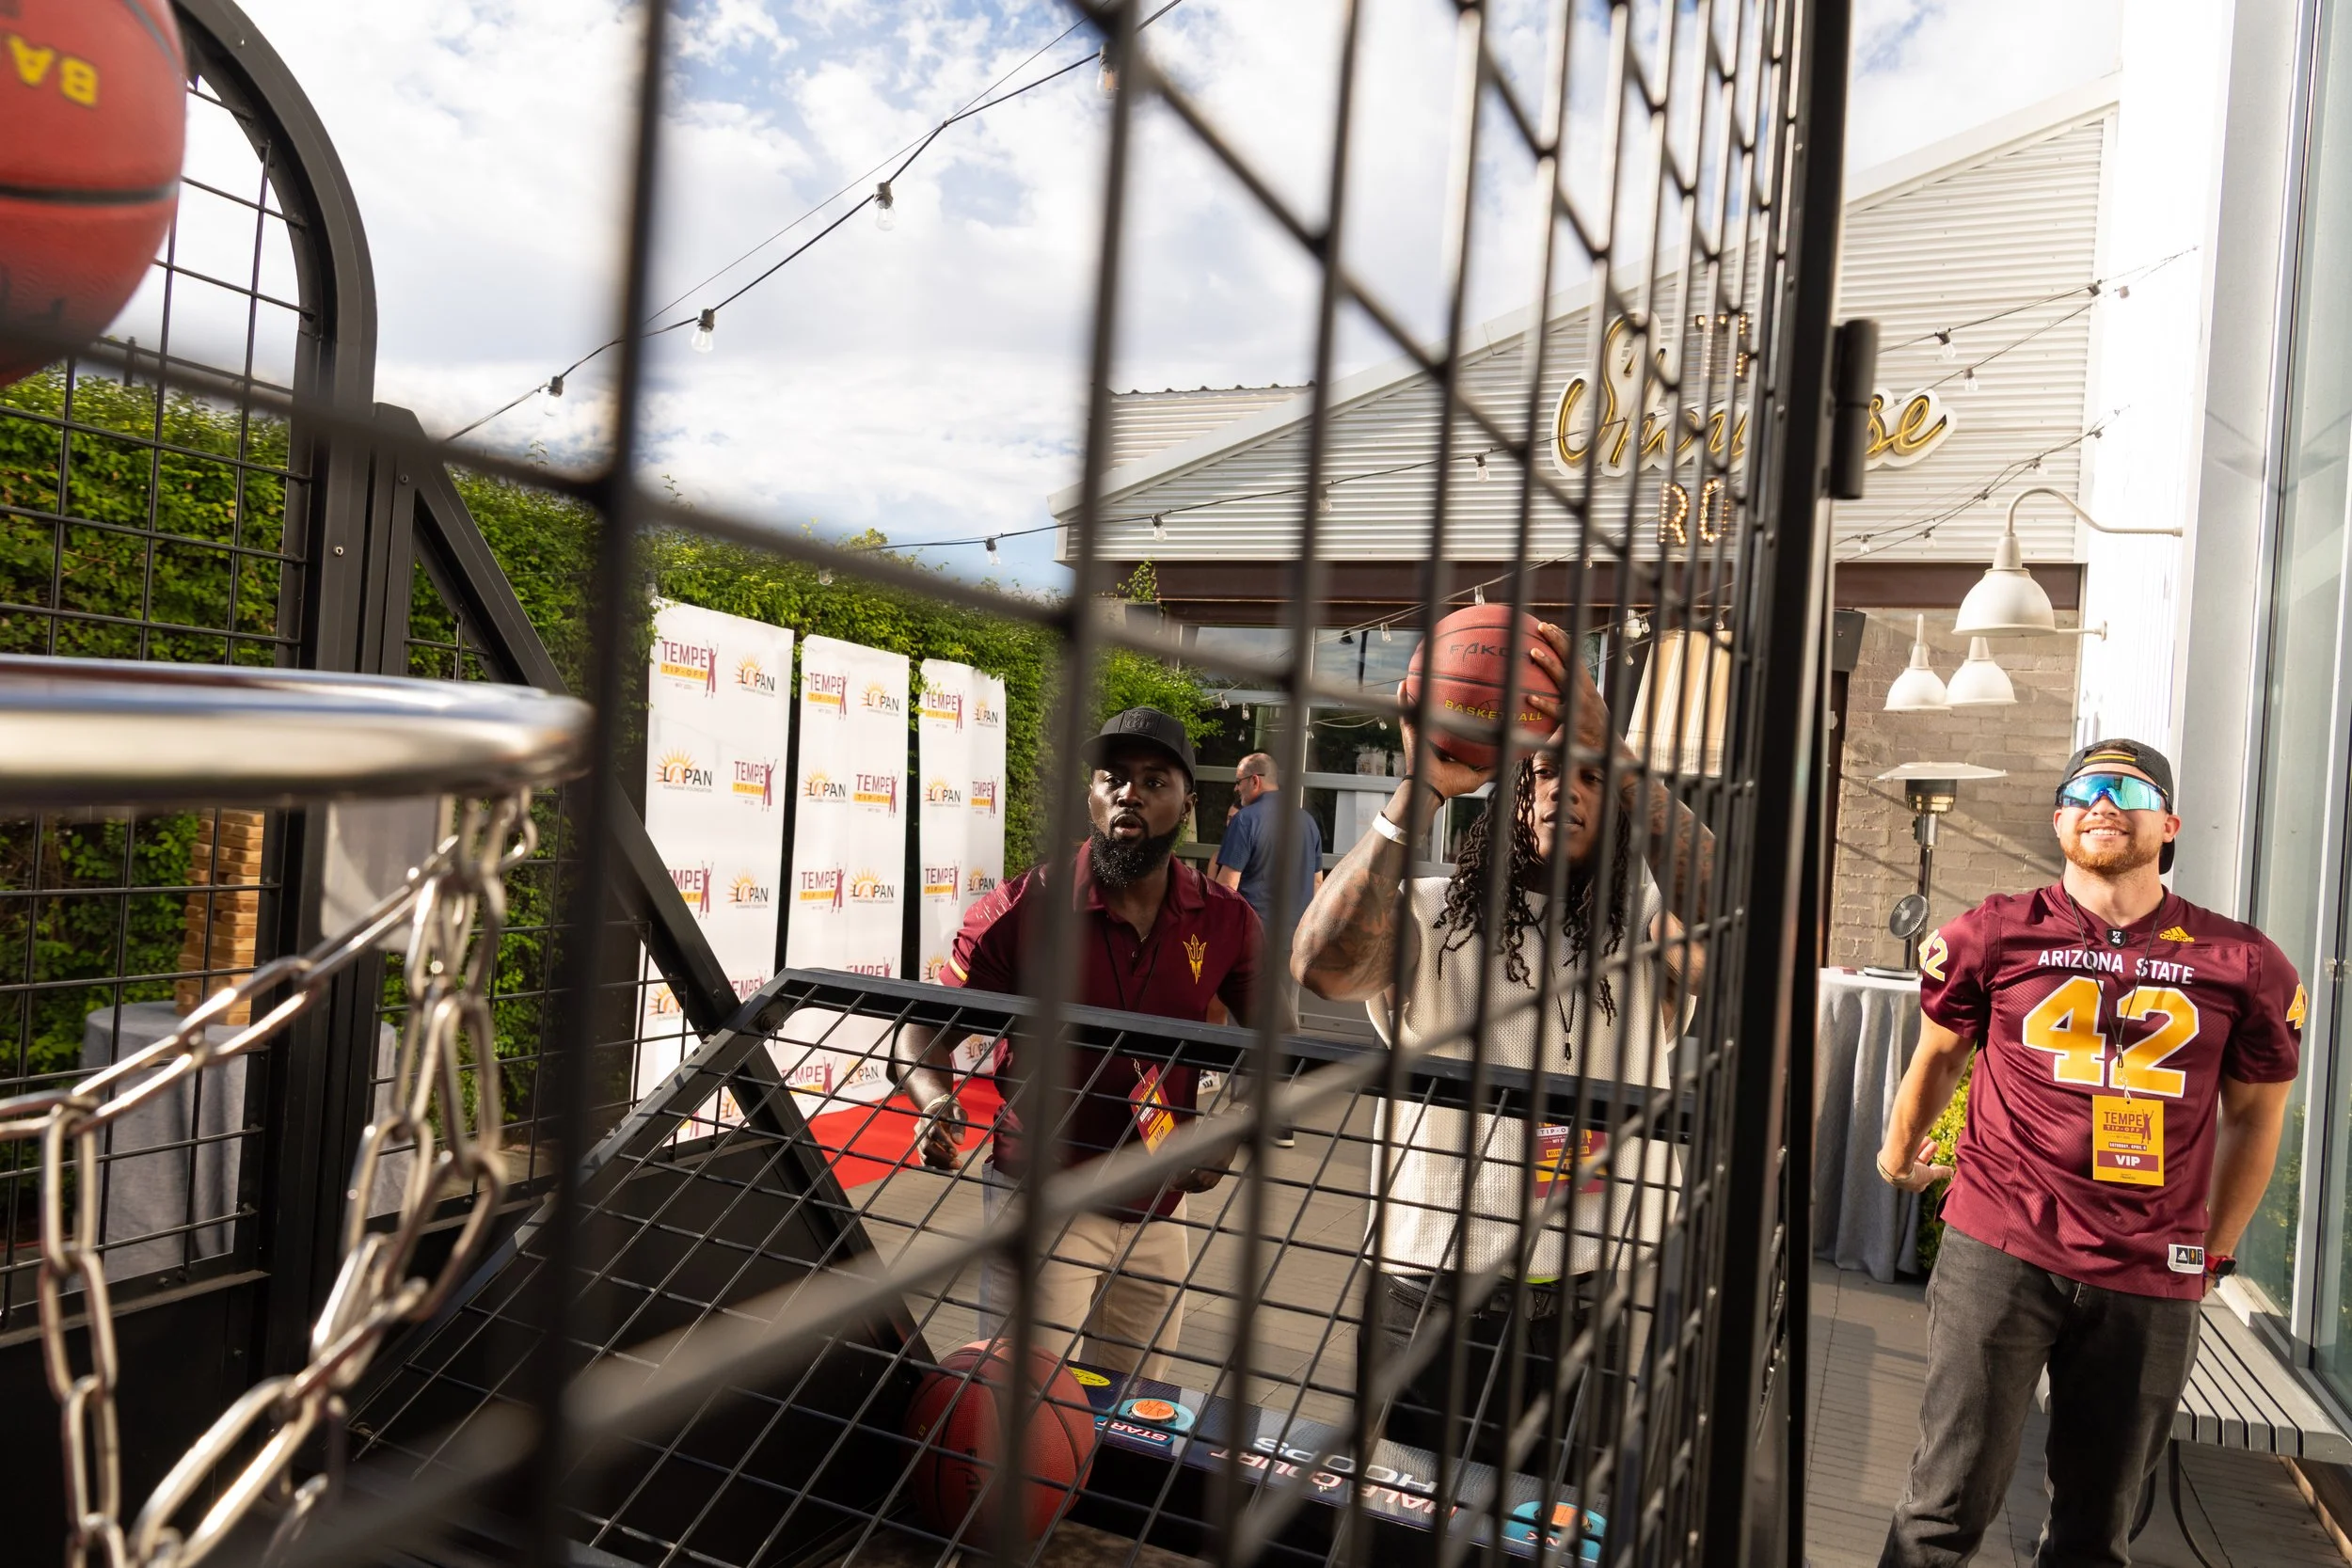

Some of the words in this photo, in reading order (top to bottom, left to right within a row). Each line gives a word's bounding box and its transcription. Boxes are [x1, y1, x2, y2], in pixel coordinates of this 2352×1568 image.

[8, 34, 99, 106] BA
[661, 641, 707, 669] TEMPE
[664, 665, 705, 677] TIP-OFF
[809, 673, 842, 694] TEMPE
[926, 691, 958, 711] TEMPE
[1444, 699, 1543, 722] BASKEALL
[734, 761, 765, 784] TEMPE
[856, 774, 891, 794] TEMPE
[972, 782, 992, 797] TEMPE
[669, 869, 702, 891] MPE
[802, 871, 836, 890] TEMPE
[925, 867, 954, 884] TEMPE
[2159, 932, 2195, 942] adidas
[1918, 928, 1948, 982] 42
[2038, 949, 2123, 974] ARIZONA
[2135, 958, 2195, 985] STATE
[2285, 982, 2309, 1030] 4
[2022, 974, 2200, 1099] 42
[2104, 1111, 2143, 1126] TEMPE
[1153, 1125, 1166, 1142] VIP
[2115, 1154, 2140, 1166] VIP
[1097, 1420, 1168, 1442] START
